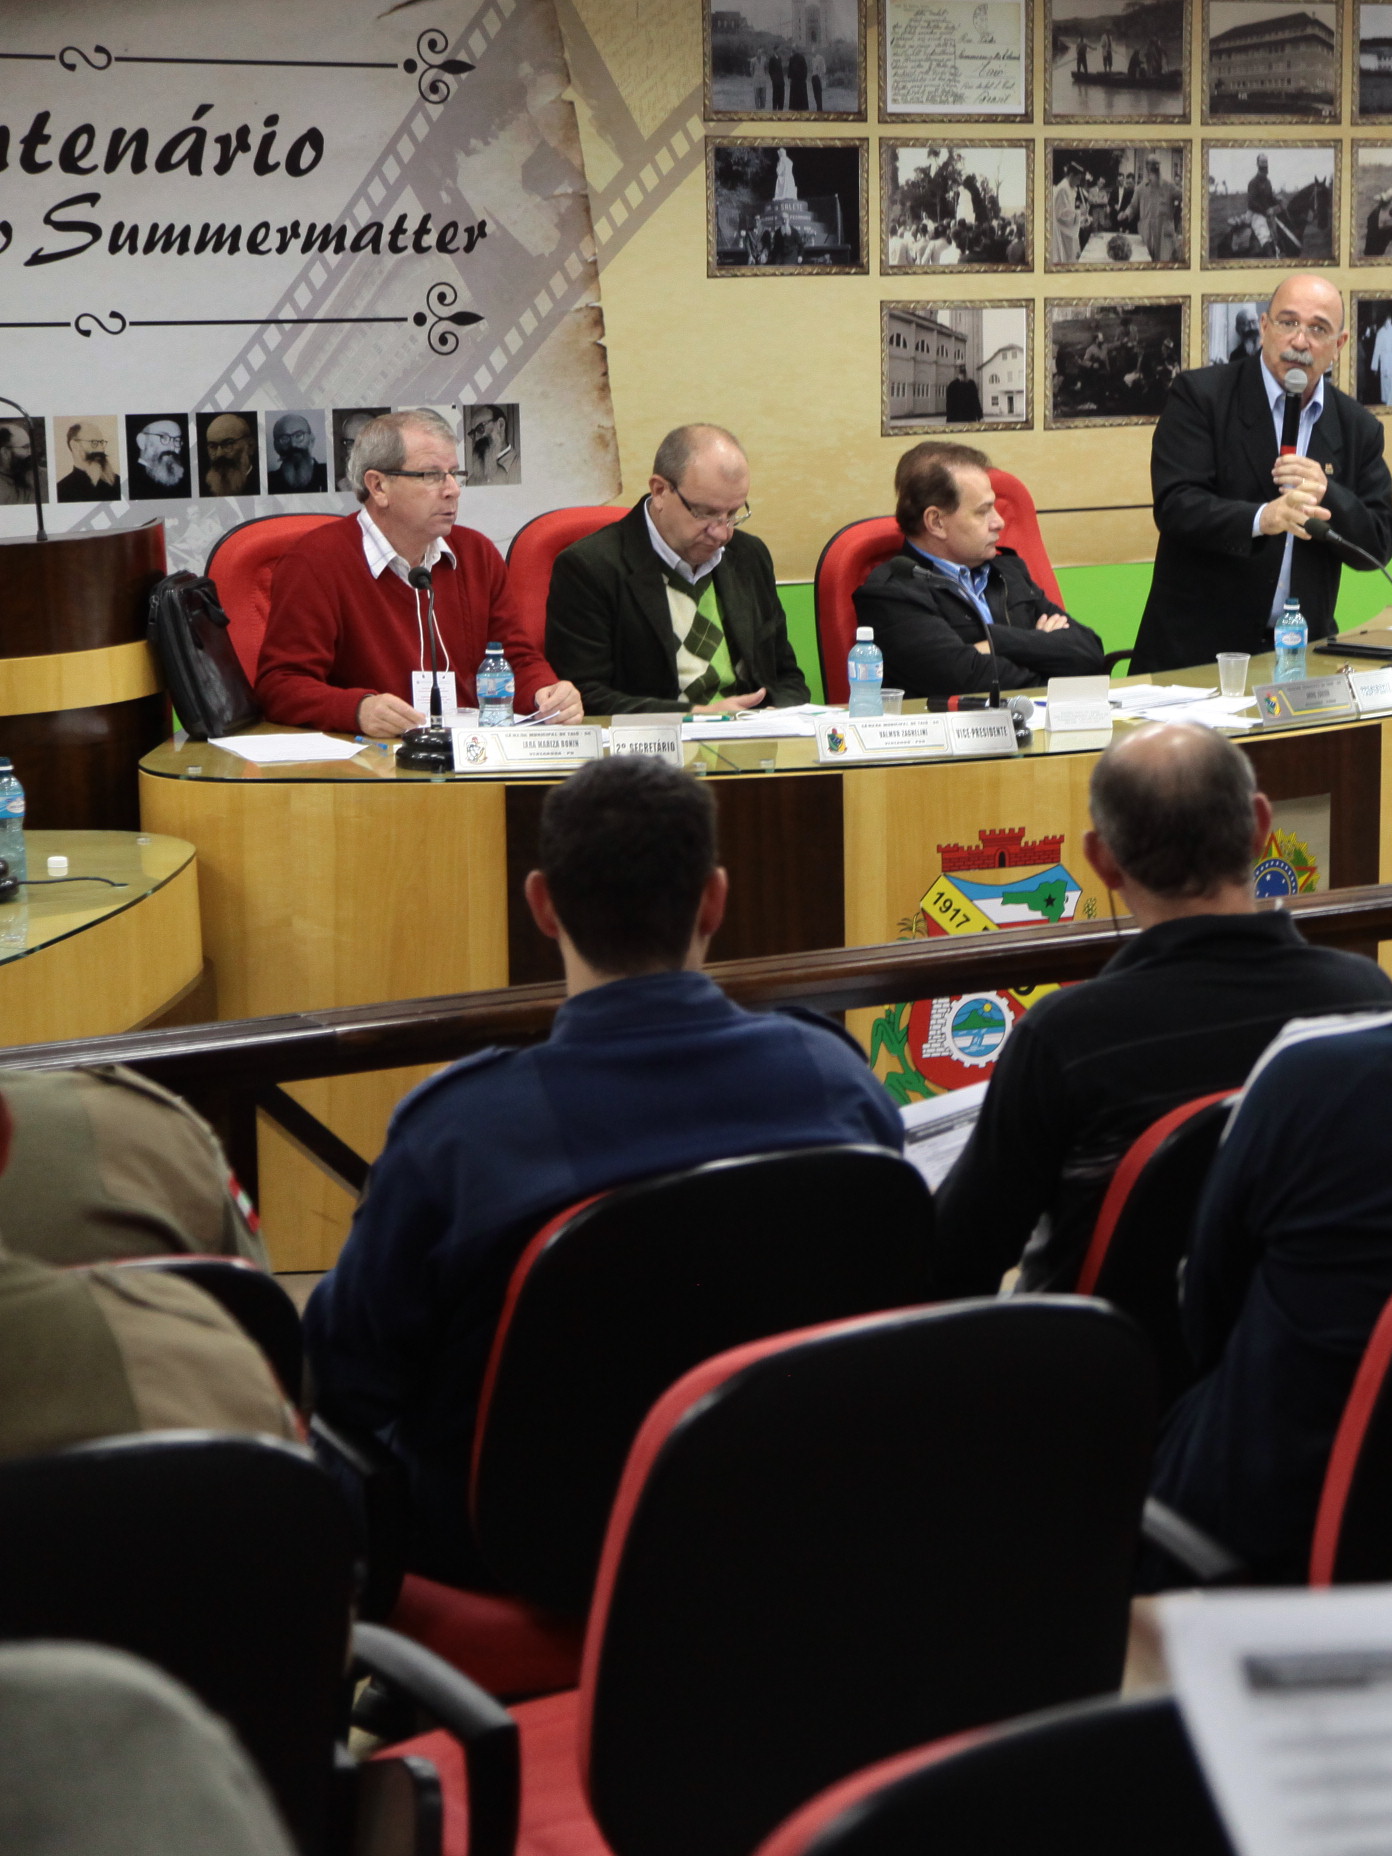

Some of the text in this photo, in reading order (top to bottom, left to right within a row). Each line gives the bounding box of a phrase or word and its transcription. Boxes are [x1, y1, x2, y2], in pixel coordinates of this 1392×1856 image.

[24, 193, 487, 267] Summermatter
[956, 725, 1008, 739] VICE-PRESIDENTE
[629, 738, 676, 754] SECRETÁRIO
[931, 891, 971, 928] 1917
